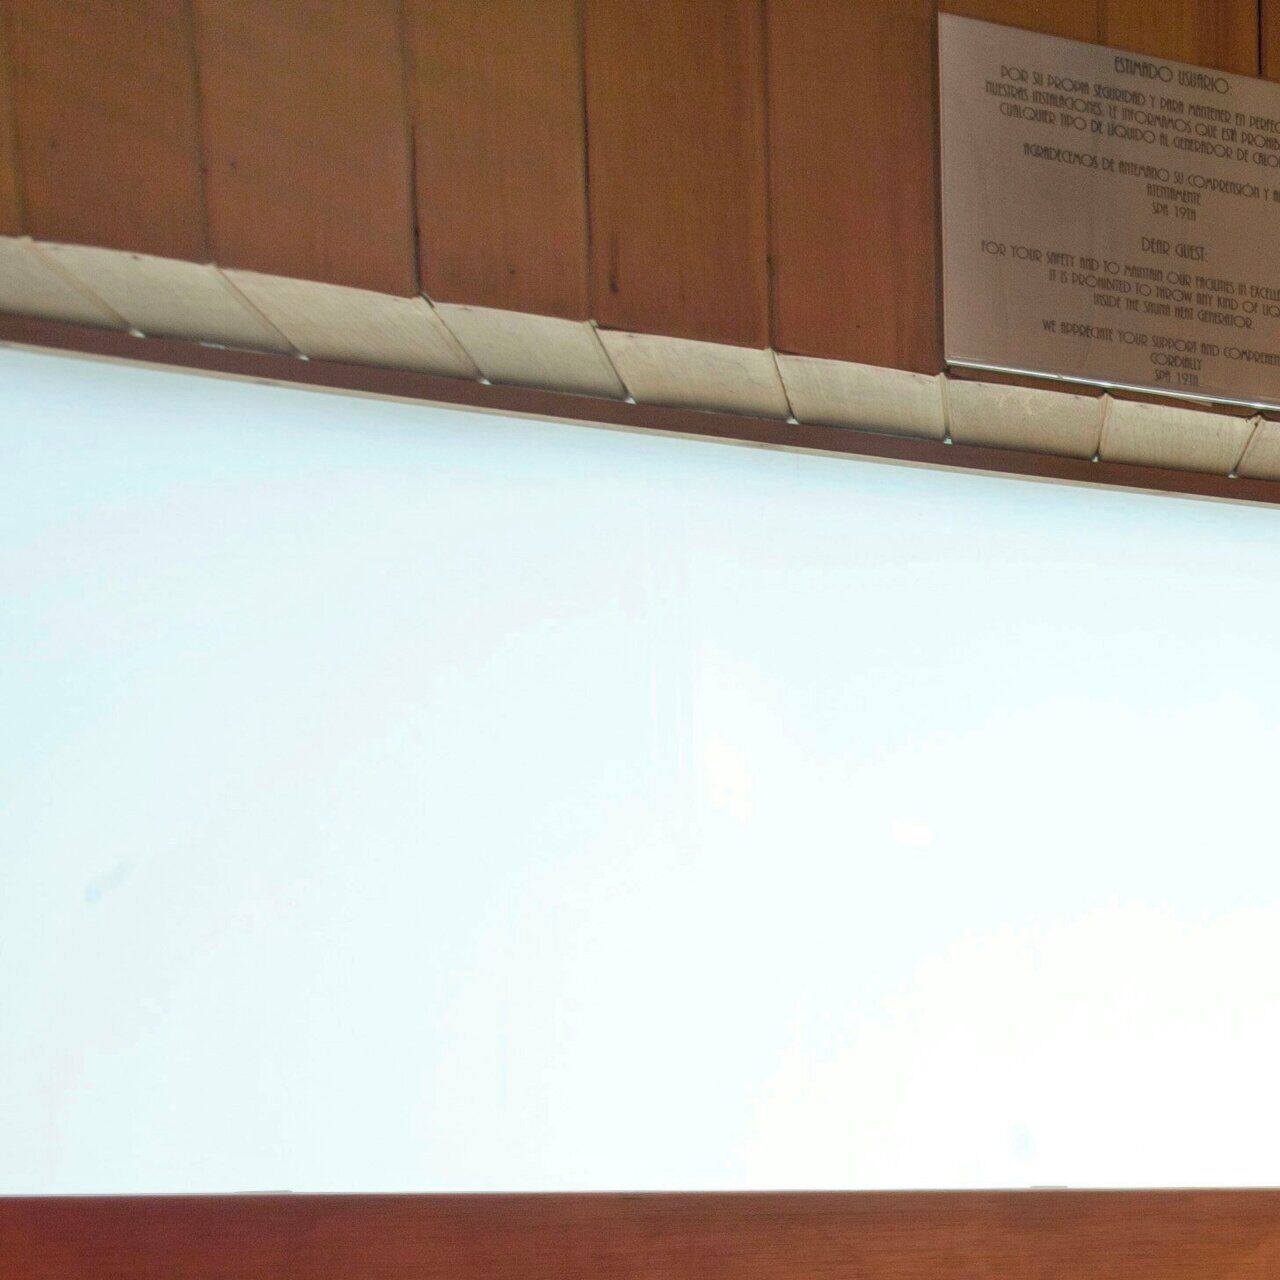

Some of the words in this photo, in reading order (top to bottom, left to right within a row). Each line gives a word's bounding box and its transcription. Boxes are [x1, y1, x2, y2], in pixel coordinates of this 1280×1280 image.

[1115, 56, 1173, 82] ESTIMADO
[986, 80, 1028, 100] NUESTRAS
[1109, 105, 1117, 119] LE
[1122, 107, 1191, 133] INFORMAMOS
[1195, 122, 1217, 139] QUE
[1001, 65, 1028, 82] POR
[1033, 72, 1043, 86] SU
[1048, 74, 1089, 94] PROPIA
[1094, 84, 1146, 105] SEGURIDAD
[1150, 97, 1156, 108] Y
[1160, 97, 1184, 113] PARA
[1188, 104, 1231, 123] MANTENER
[1236, 113, 1245, 126] EN
[1000, 102, 1056, 124] CUALQUIER
[1061, 113, 1087, 131] TIPO
[1091, 119, 1102, 135] DE
[1160, 132, 1168, 147] AL
[1173, 136, 1233, 158] GENERADOR
[1237, 148, 1248, 162] DE
[1023, 142, 1098, 169] AGRADECEMOS
[1102, 158, 1114, 172] DE
[1118, 161, 1170, 182] ANTEMANO
[1174, 171, 1184, 185] SU
[1264, 184, 1270, 201] Y
[1146, 184, 1200, 205] ATENTAMENTE
[1152, 201, 1169, 216] SPA
[1142, 237, 1169, 255] DEAR
[982, 240, 1006, 256] FOR
[1010, 245, 1041, 261] YOUR
[1046, 252, 1075, 267] SAFETY
[1080, 257, 1099, 271] AND
[1103, 260, 1119, 274] TO
[1124, 265, 1162, 282] MAINTAIN
[1167, 271, 1191, 286] OUR
[1196, 276, 1234, 294] FACILITIES
[1238, 284, 1246, 296] IN
[1050, 269, 1056, 281] IT
[1060, 271, 1068, 284] IS
[1072, 273, 1131, 293] PROHIBITED
[1135, 283, 1151, 297] TO
[1156, 286, 1192, 302] THROW
[1196, 293, 1213, 306] ANY
[1217, 297, 1238, 311] KIND
[1242, 300, 1258, 314] OF
[1094, 293, 1121, 309] INSIDE
[1126, 298, 1139, 312] THE
[1143, 301, 1171, 317] SAUNA
[1175, 307, 1193, 321] HEAT
[1042, 319, 1056, 333] WE
[1061, 321, 1113, 341] APPRECIATE
[1118, 330, 1148, 346] YOUR
[1152, 335, 1197, 353] SUPPORT
[1201, 342, 1219, 356] AND
[1151, 352, 1202, 371] CORDIALLY
[1155, 369, 1170, 382] SPA
